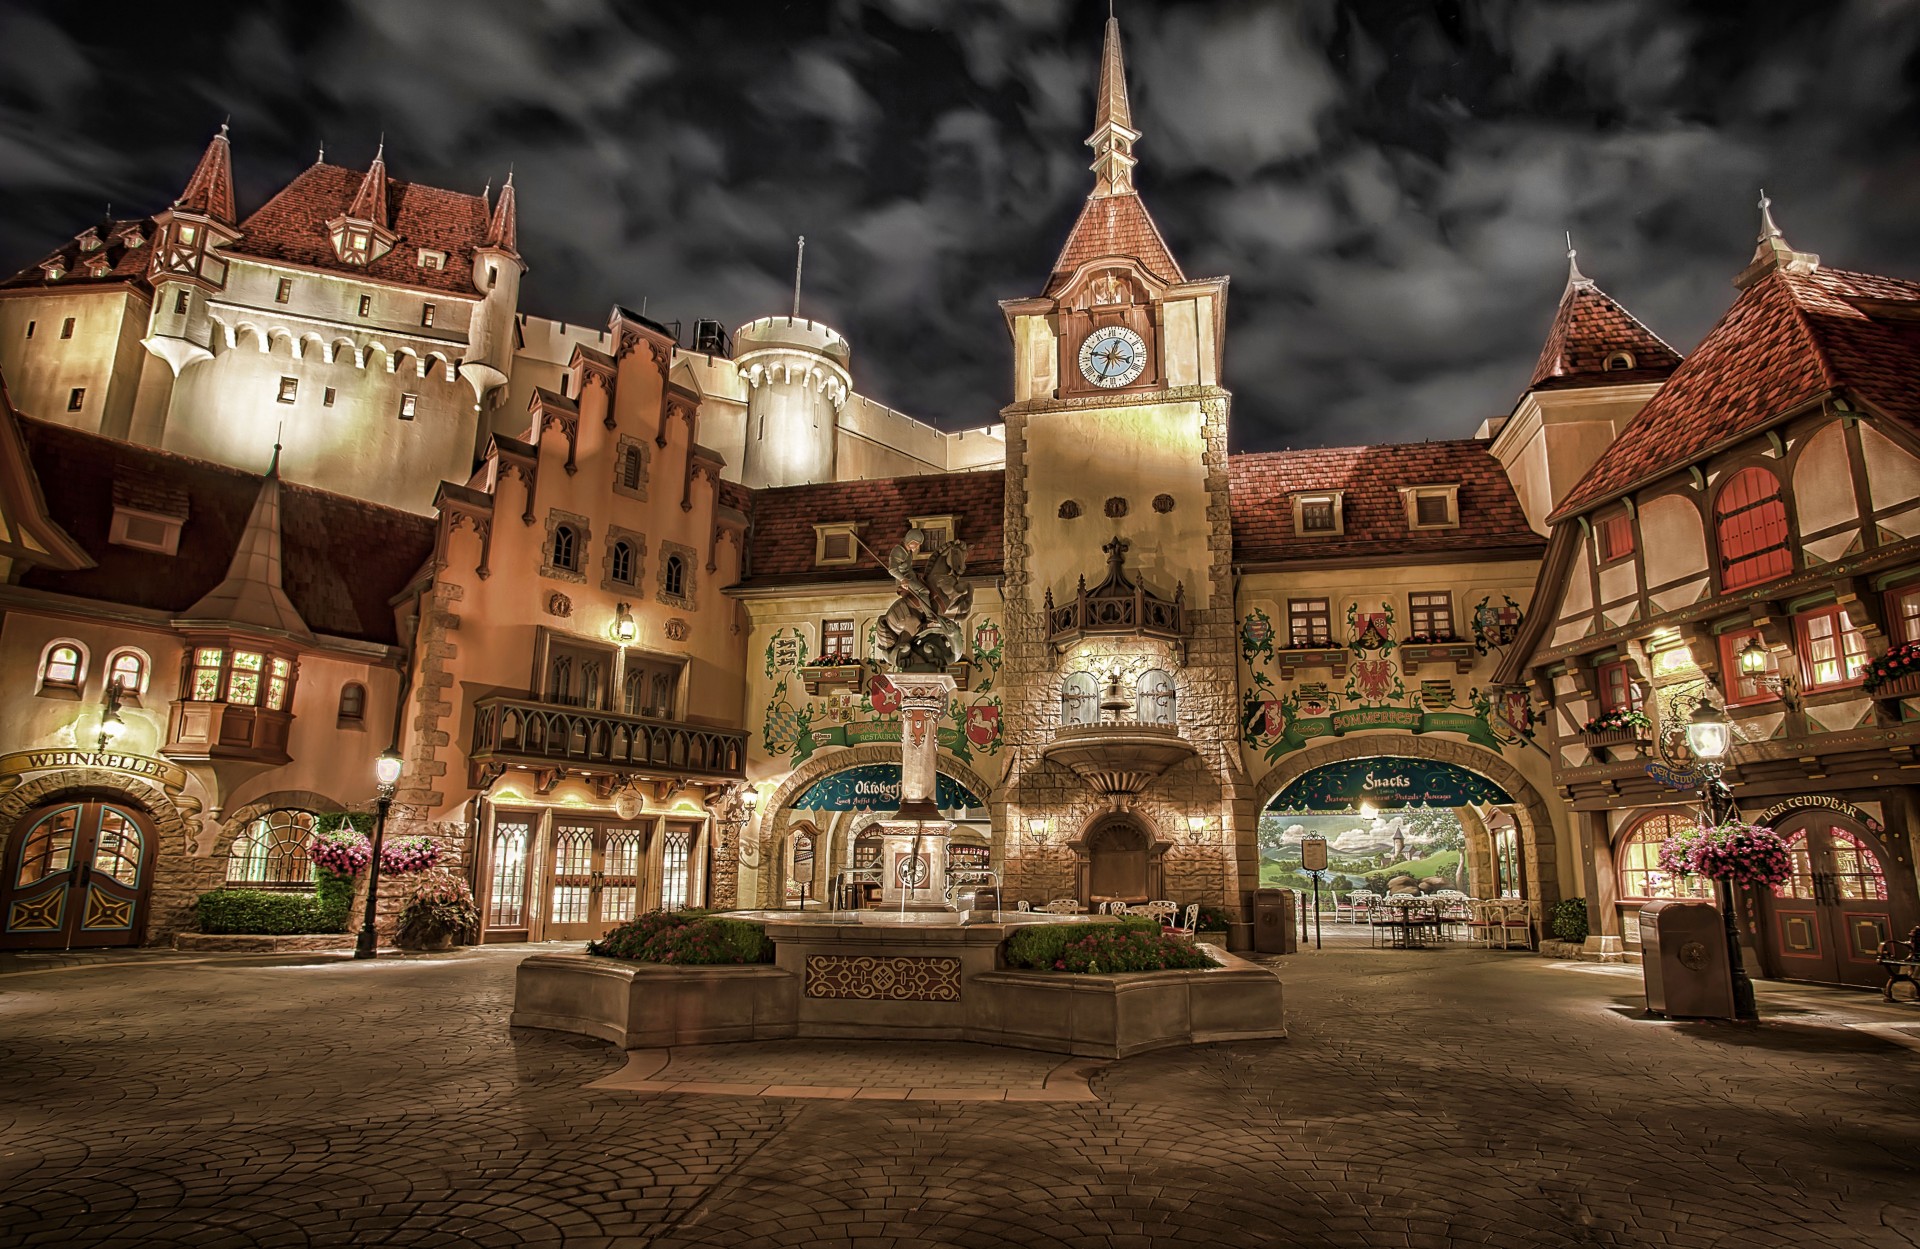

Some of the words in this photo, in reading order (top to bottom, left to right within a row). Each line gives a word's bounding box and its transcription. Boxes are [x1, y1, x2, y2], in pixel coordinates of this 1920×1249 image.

[847, 721, 903, 736] BIERGAR
[1333, 711, 1423, 731] SOMMERFEST
[860, 733, 902, 741] RESTAURAN
[27, 752, 169, 778] WEINKELLER
[1362, 771, 1411, 790] Snacks
[1651, 766, 1668, 778] DER
[1669, 770, 1702, 784] TEDDYB
[855, 780, 902, 800] Oktoberf
[1762, 802, 1787, 822] DER
[1786, 795, 1857, 818] TEDDYBÄR
